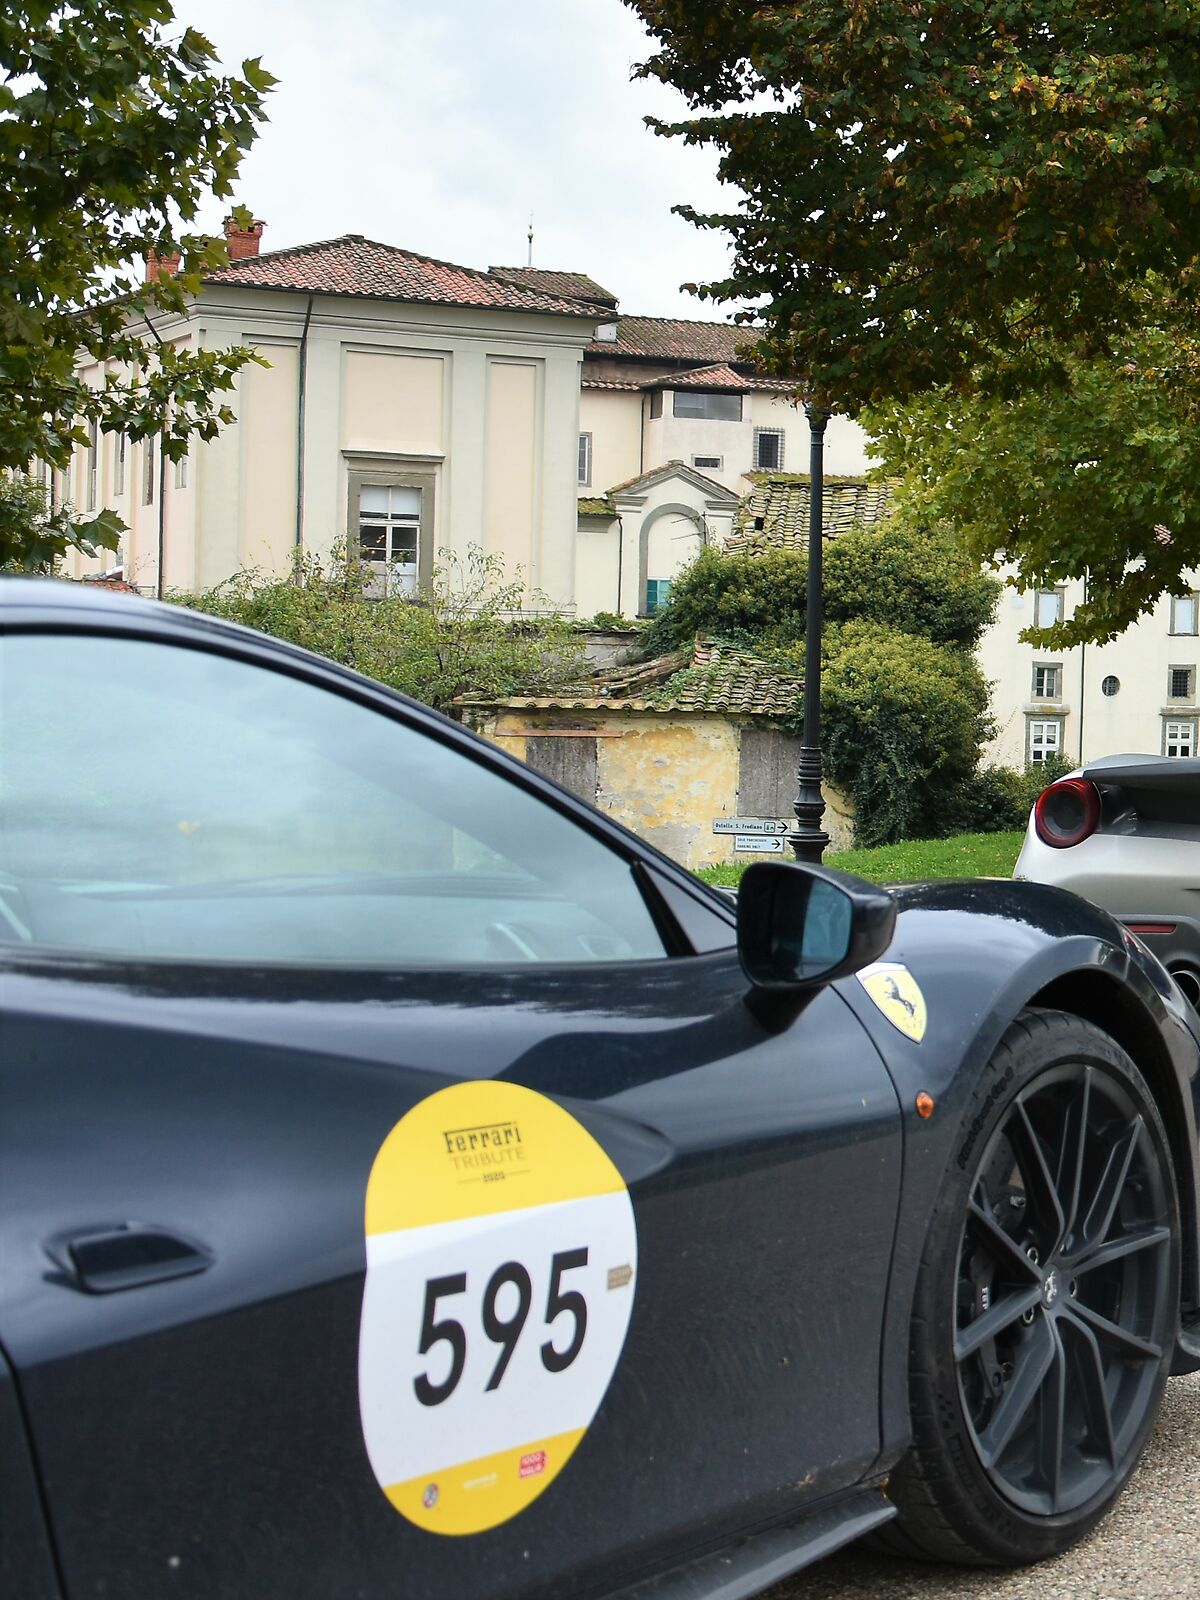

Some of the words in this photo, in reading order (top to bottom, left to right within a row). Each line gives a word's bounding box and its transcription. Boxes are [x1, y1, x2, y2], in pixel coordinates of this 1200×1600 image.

[443, 1121, 522, 1154] Ferrari
[452, 1147, 527, 1170] TRIBUTE
[413, 1246, 589, 1407] 595
